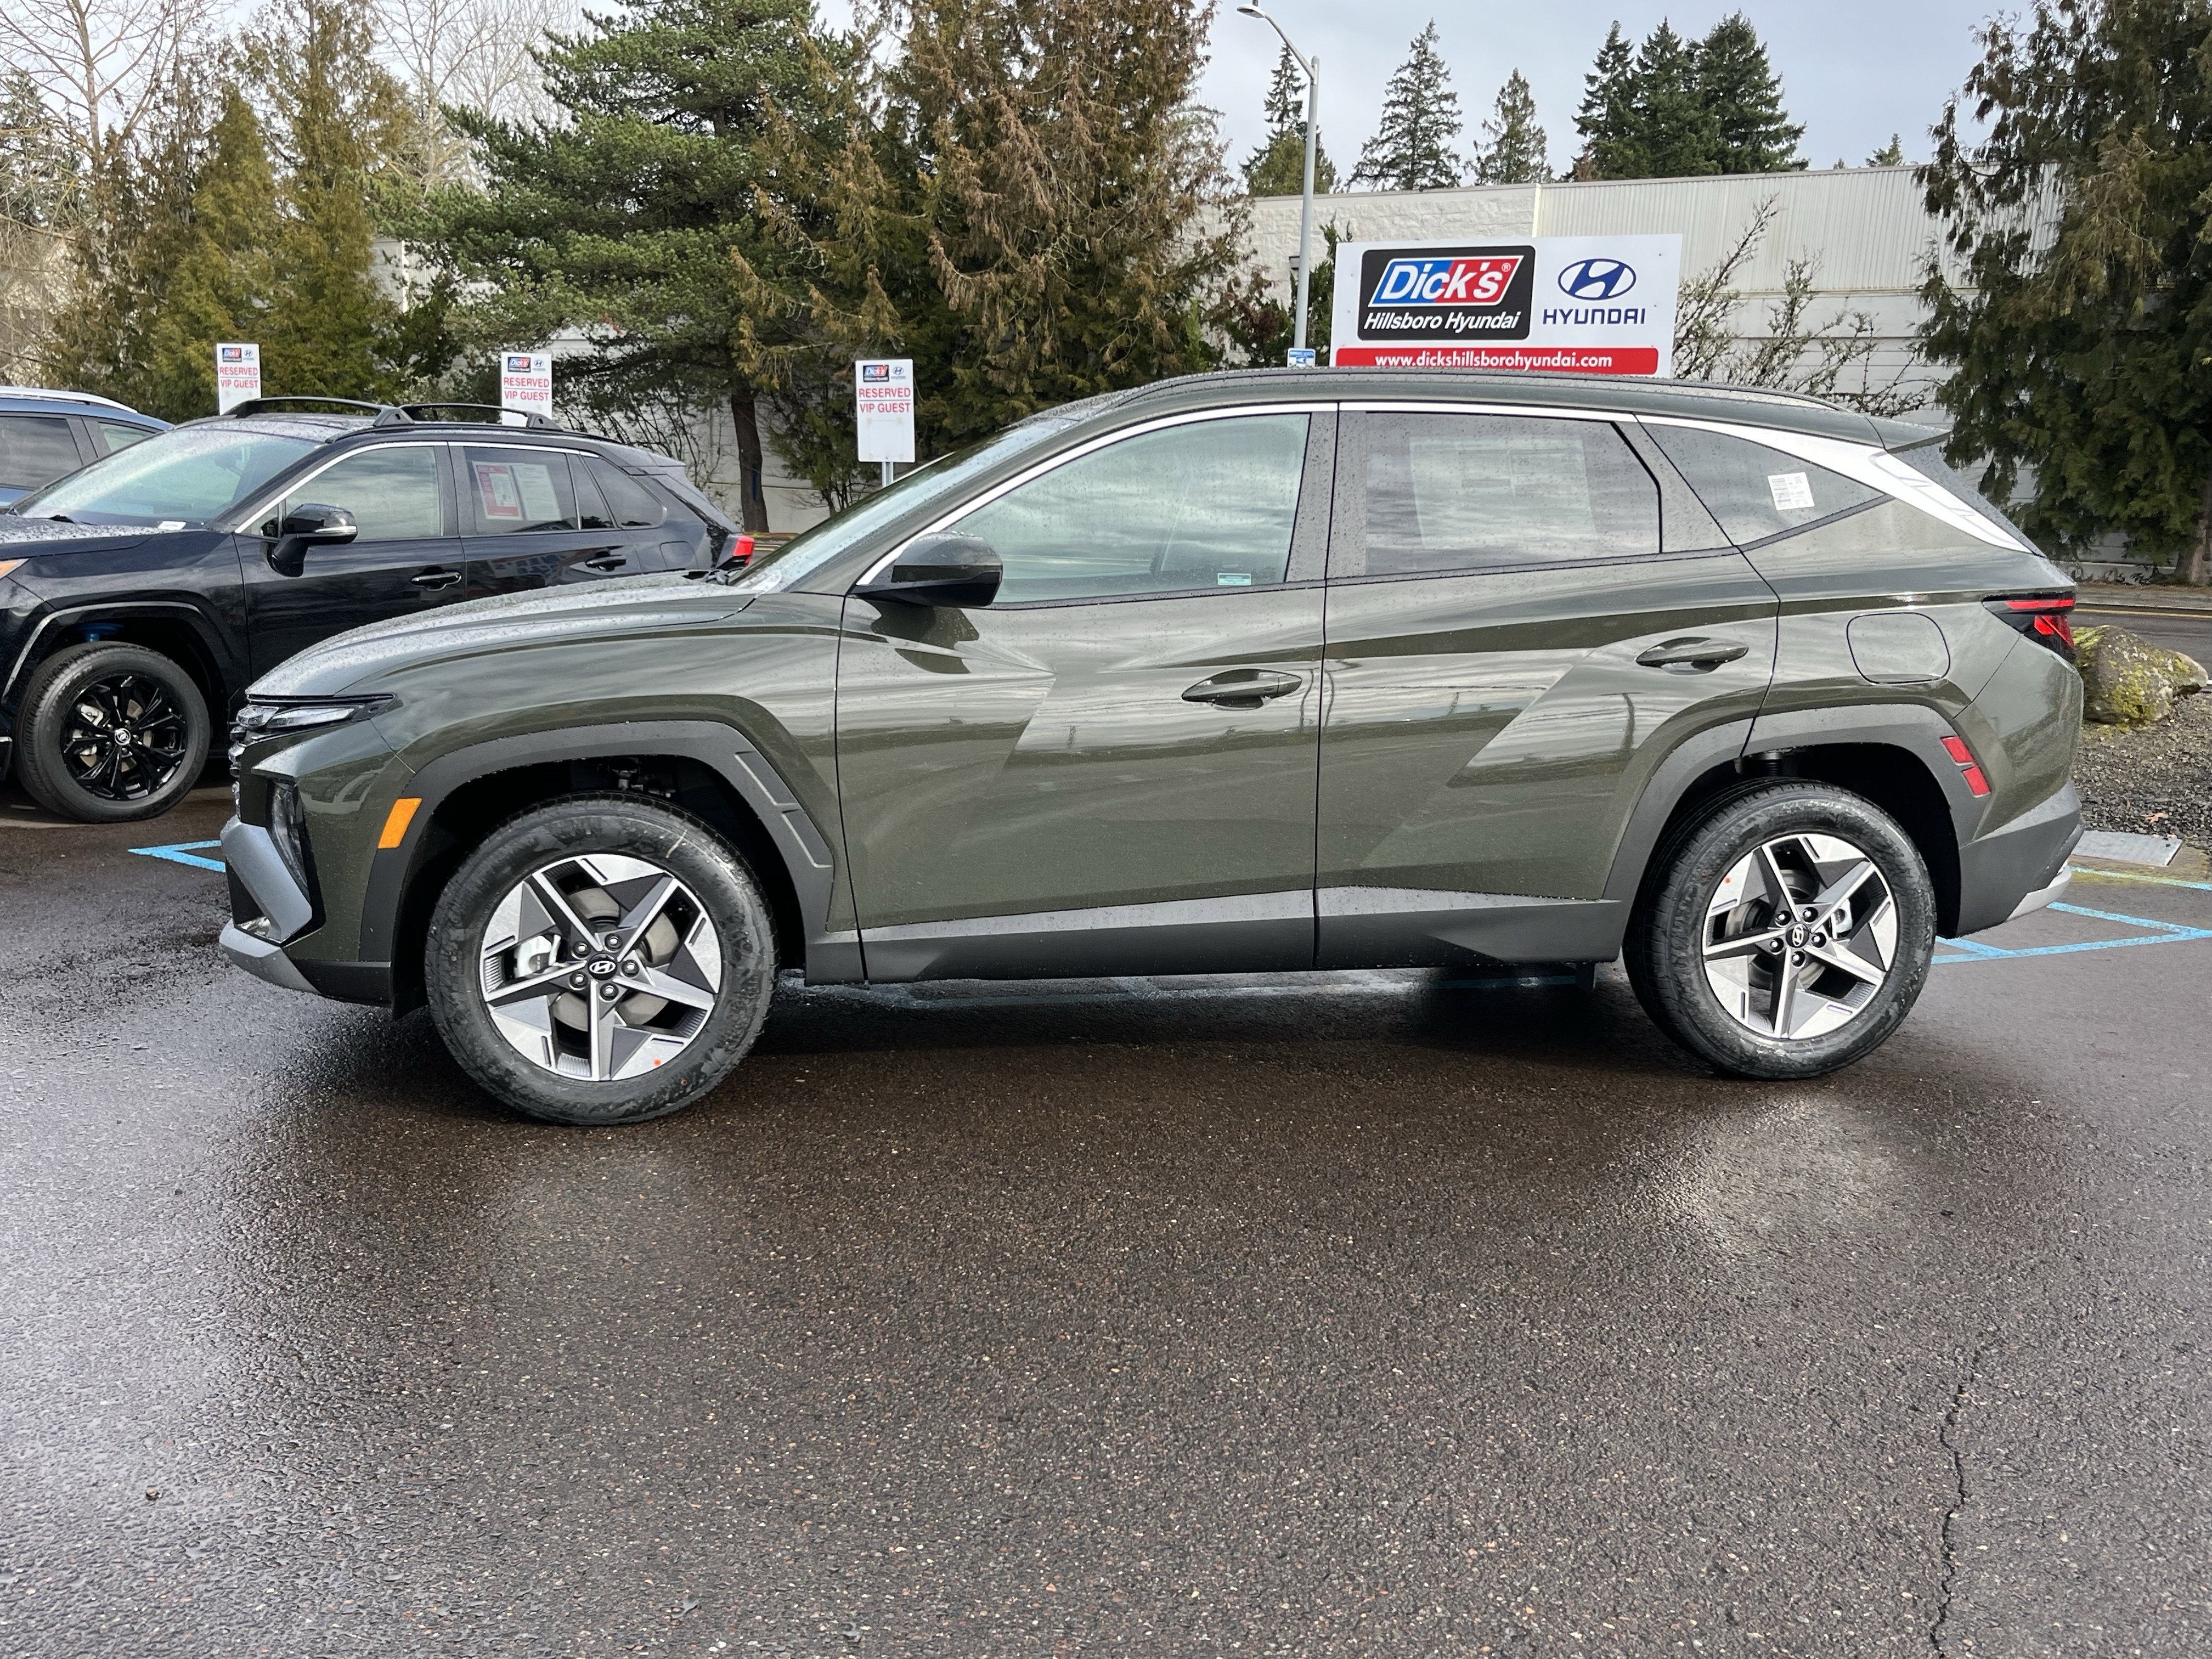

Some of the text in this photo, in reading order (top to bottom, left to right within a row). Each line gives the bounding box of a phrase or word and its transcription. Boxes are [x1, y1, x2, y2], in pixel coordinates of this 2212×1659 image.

[1543, 308, 1646, 325] HYUNDAI
[1364, 311, 1521, 334] Hillsboro Hyundai
[1375, 350, 1612, 371] www.dickshillsborohyundai.com
[219, 366, 258, 376] RESERVED
[221, 379, 258, 388] VIP GUEST
[504, 377, 549, 387] RESERVED
[504, 391, 549, 401] VIP GUEST
[859, 387, 911, 398] RESERVED
[860, 403, 911, 413] VIP GUEST
